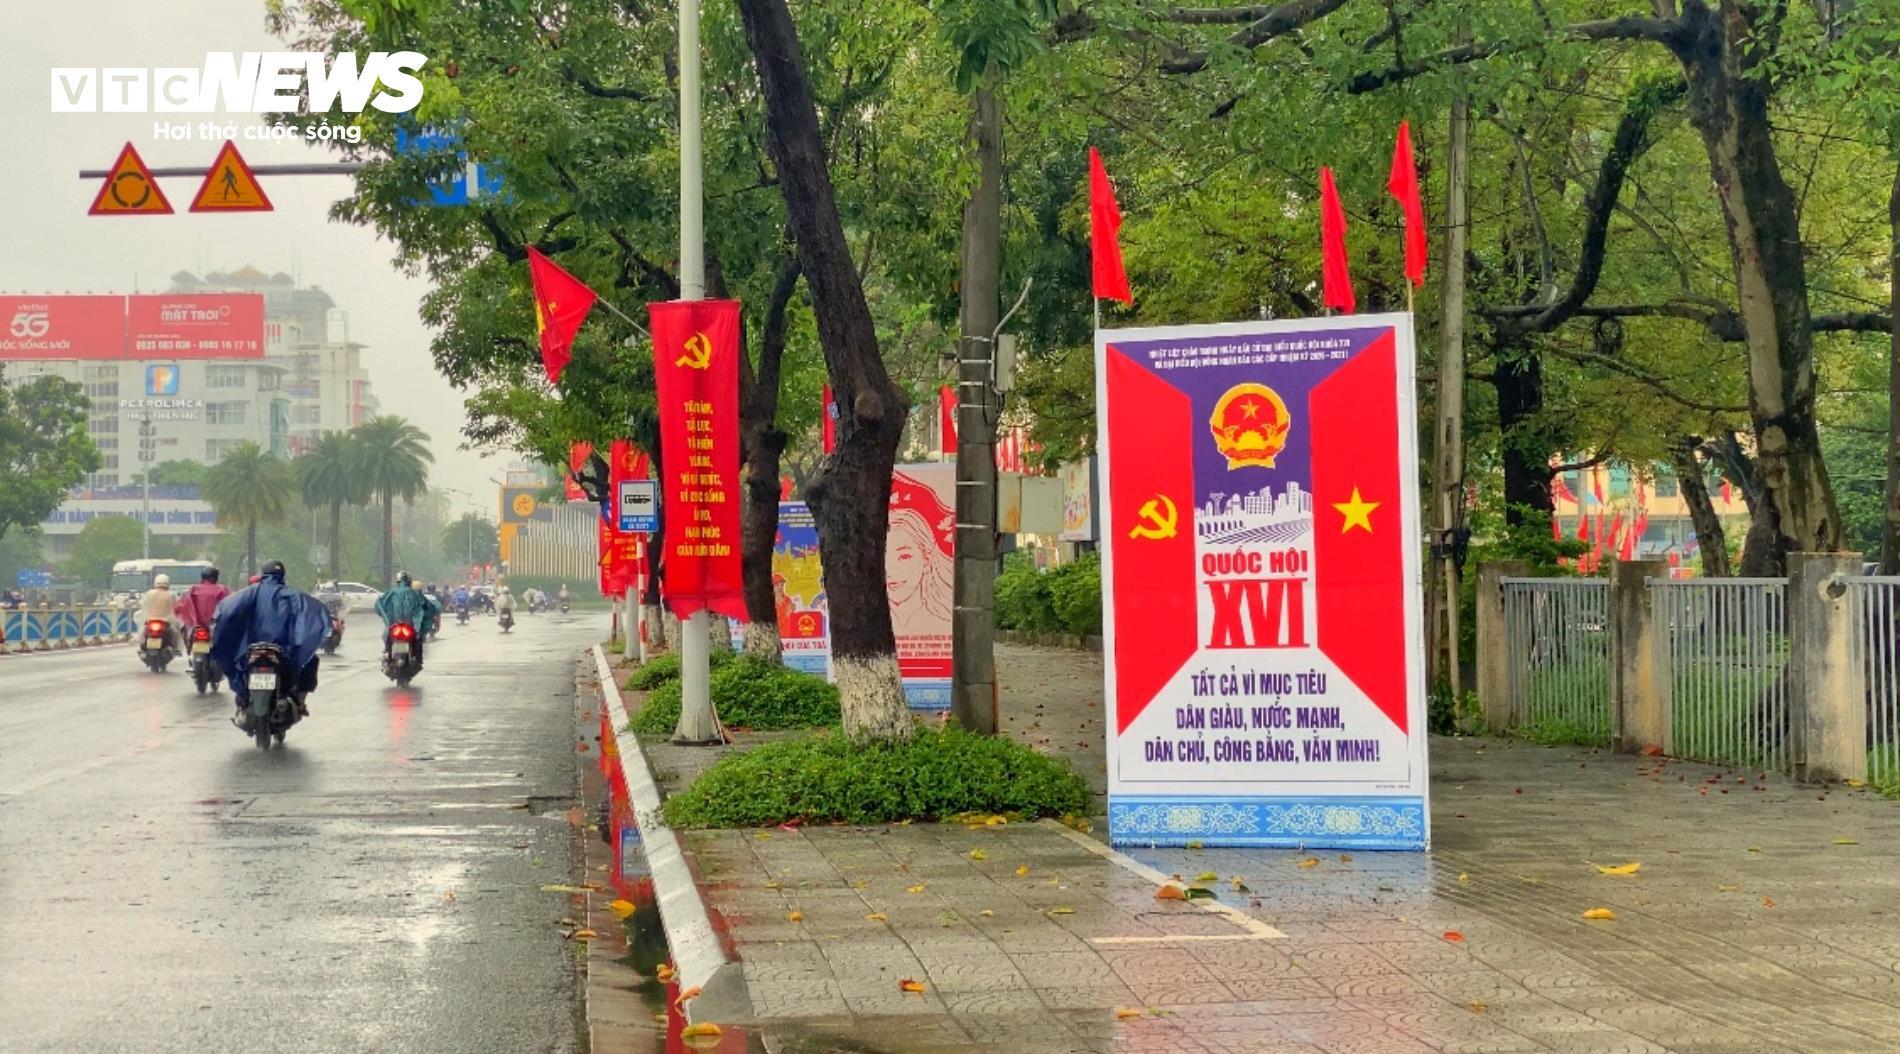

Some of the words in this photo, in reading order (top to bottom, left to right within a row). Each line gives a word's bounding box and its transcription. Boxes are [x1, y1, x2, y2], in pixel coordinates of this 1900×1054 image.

[10, 312, 50, 337] 5G
[1202, 545, 1262, 576] QUỐC
[1270, 547, 1308, 574] HỘI
[1203, 578, 1310, 649] XVI
[1191, 666, 1216, 696] TẤT
[1219, 665, 1239, 695] CẢ
[1243, 669, 1256, 695] VÌ
[1260, 673, 1292, 698] MỤC
[1296, 668, 1326, 695] TIÊU
[1176, 704, 1205, 729] DÂN
[1210, 705, 1248, 732] GIÀU,
[1252, 698, 1292, 729] NƯỚC
[1296, 707, 1345, 732] MẠNH,
[1145, 737, 1173, 763] DÂN
[1178, 731, 1210, 763] CHỦ,
[1214, 737, 1252, 762] CÔNG
[1256, 731, 1299, 763] BẰNG,
[1303, 735, 1332, 762] VĂN
[1336, 740, 1380, 763] MINH!
